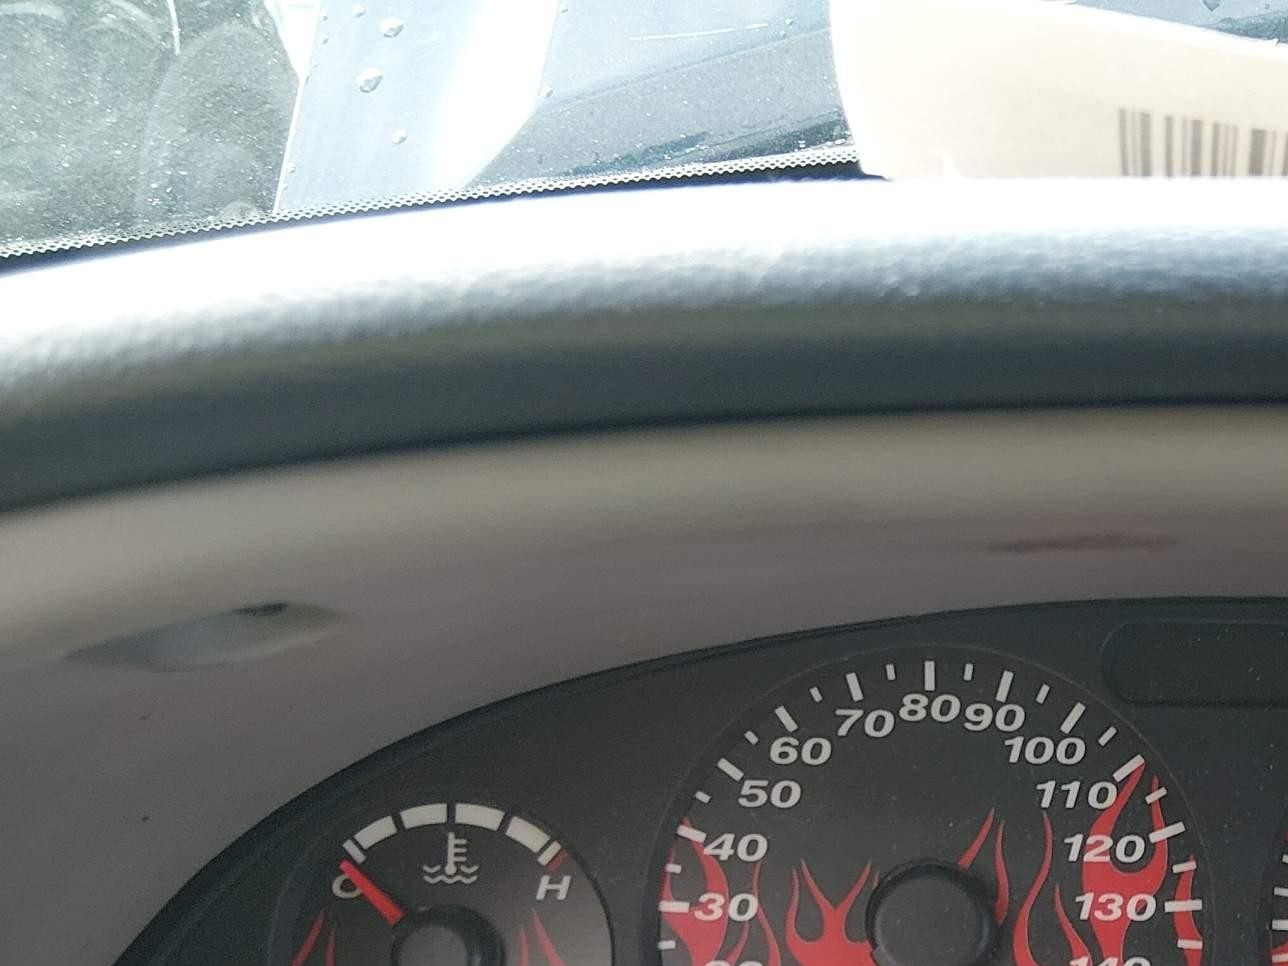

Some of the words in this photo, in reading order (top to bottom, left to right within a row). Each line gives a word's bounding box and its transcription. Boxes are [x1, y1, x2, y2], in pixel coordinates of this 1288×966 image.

[899, 693, 961, 722] 80
[964, 703, 1026, 731] 90
[834, 709, 895, 737] 70
[769, 736, 832, 765] 60
[1003, 736, 1086, 764] 100
[738, 779, 802, 808] 50
[1036, 780, 1118, 809] 110
[703, 833, 768, 861] 40
[1063, 833, 1145, 862] 120
[331, 872, 366, 899] C
[535, 875, 572, 900] H
[694, 892, 758, 921] 30
[1075, 892, 1157, 921] 130
